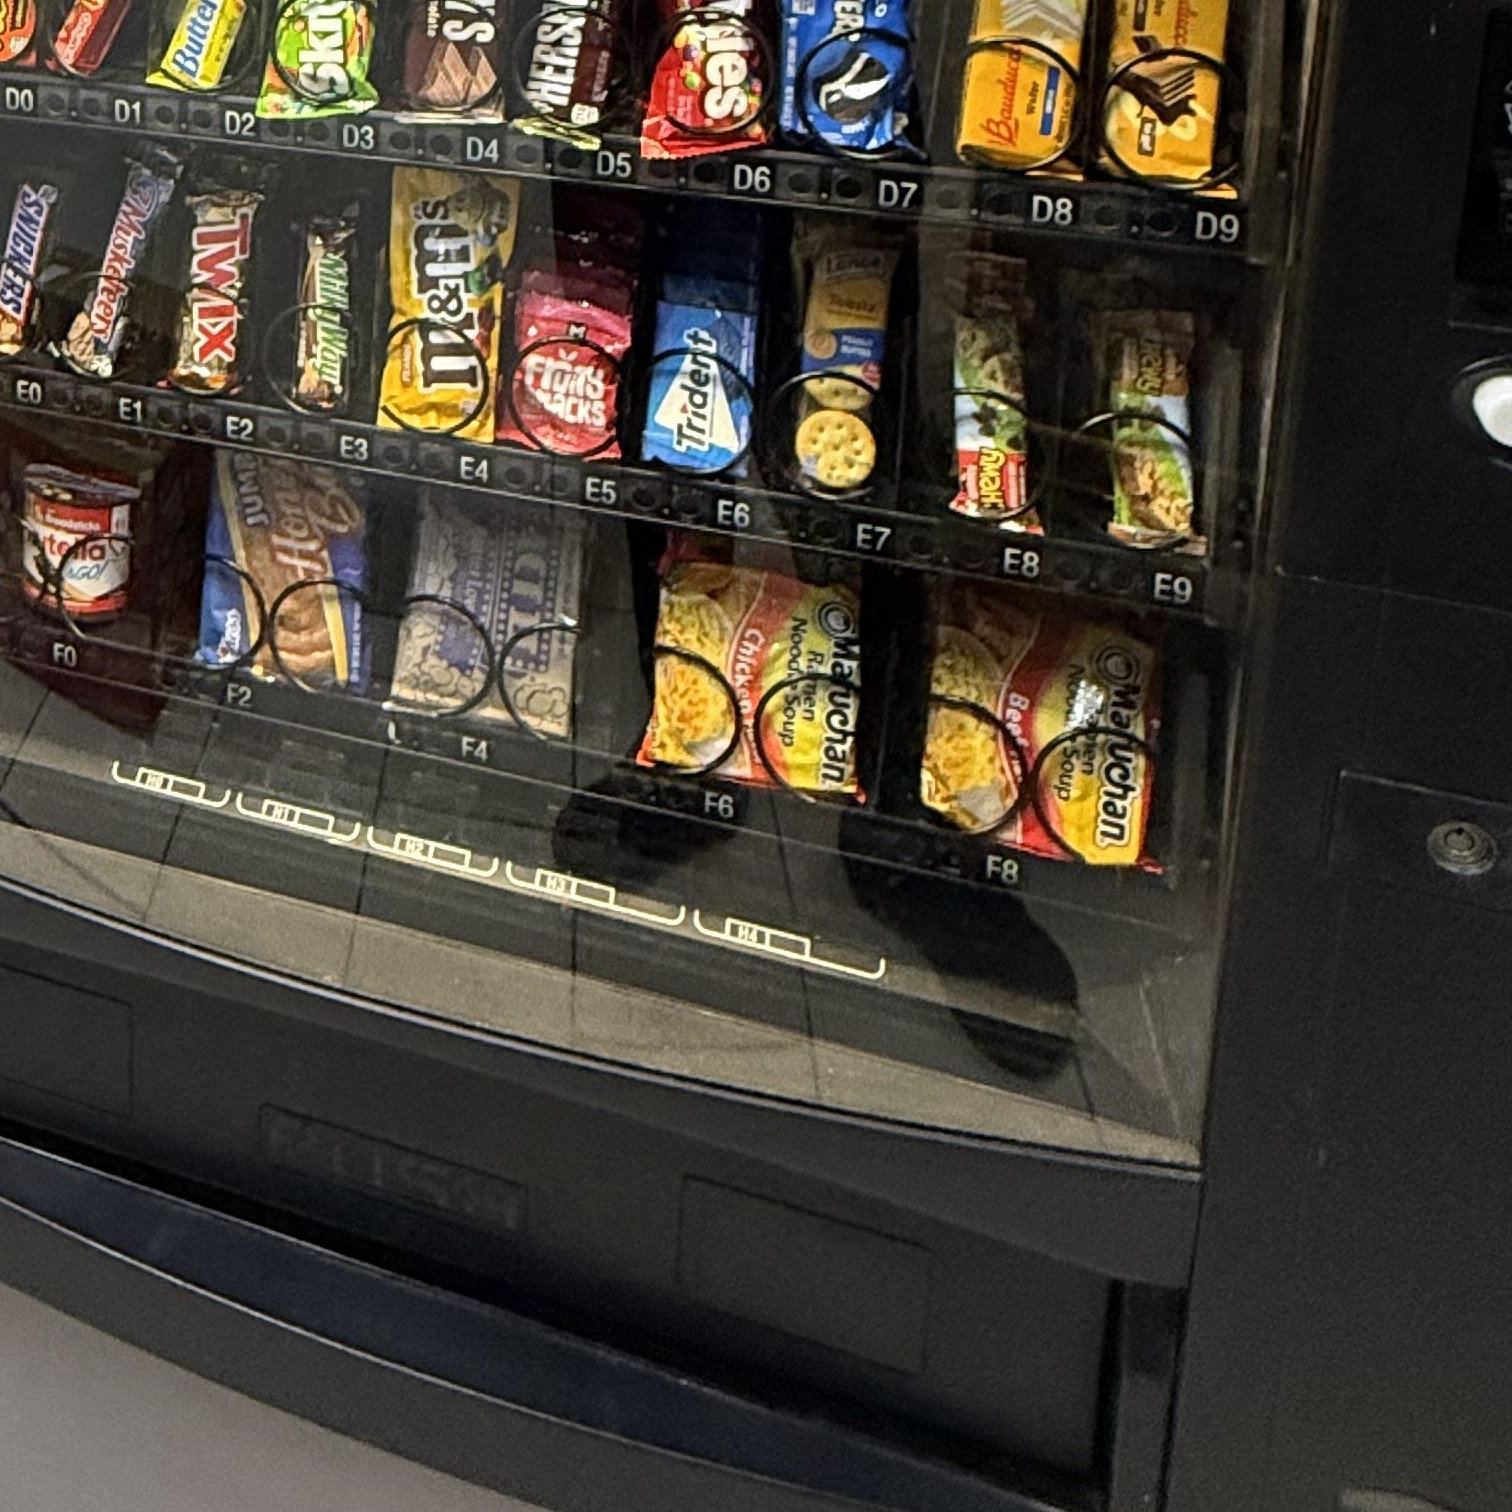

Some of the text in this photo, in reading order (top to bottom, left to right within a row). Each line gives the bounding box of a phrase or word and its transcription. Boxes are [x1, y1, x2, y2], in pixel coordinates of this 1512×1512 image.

[6, 87, 34, 111] D0
[115, 100, 141, 124] D1
[225, 111, 255, 136] D2
[342, 125, 374, 149] D3
[466, 138, 499, 163] D4
[597, 151, 632, 176] D5
[734, 164, 771, 192] D6
[879, 180, 917, 208] D7
[1032, 196, 1073, 225] D8
[1195, 212, 1238, 243] D9
[193, 211, 251, 364] TWIX
[16, 381, 41, 403] E0
[676, 329, 717, 450] Trident
[119, 402, 142, 422] E1
[226, 418, 253, 440] E2
[341, 439, 368, 460] E3
[461, 457, 488, 481] E4
[586, 479, 617, 504] E5
[717, 500, 750, 527] E6
[856, 524, 891, 551] E7
[1003, 549, 1039, 578] E8
[1154, 573, 1192, 604] E9
[53, 643, 77, 667] F0
[226, 685, 252, 708] F2
[779, 694, 798, 749] Soup
[461, 736, 489, 761] F4
[1056, 745, 1080, 803] Soup
[704, 793, 734, 819] F6
[986, 856, 1019, 885] F8
